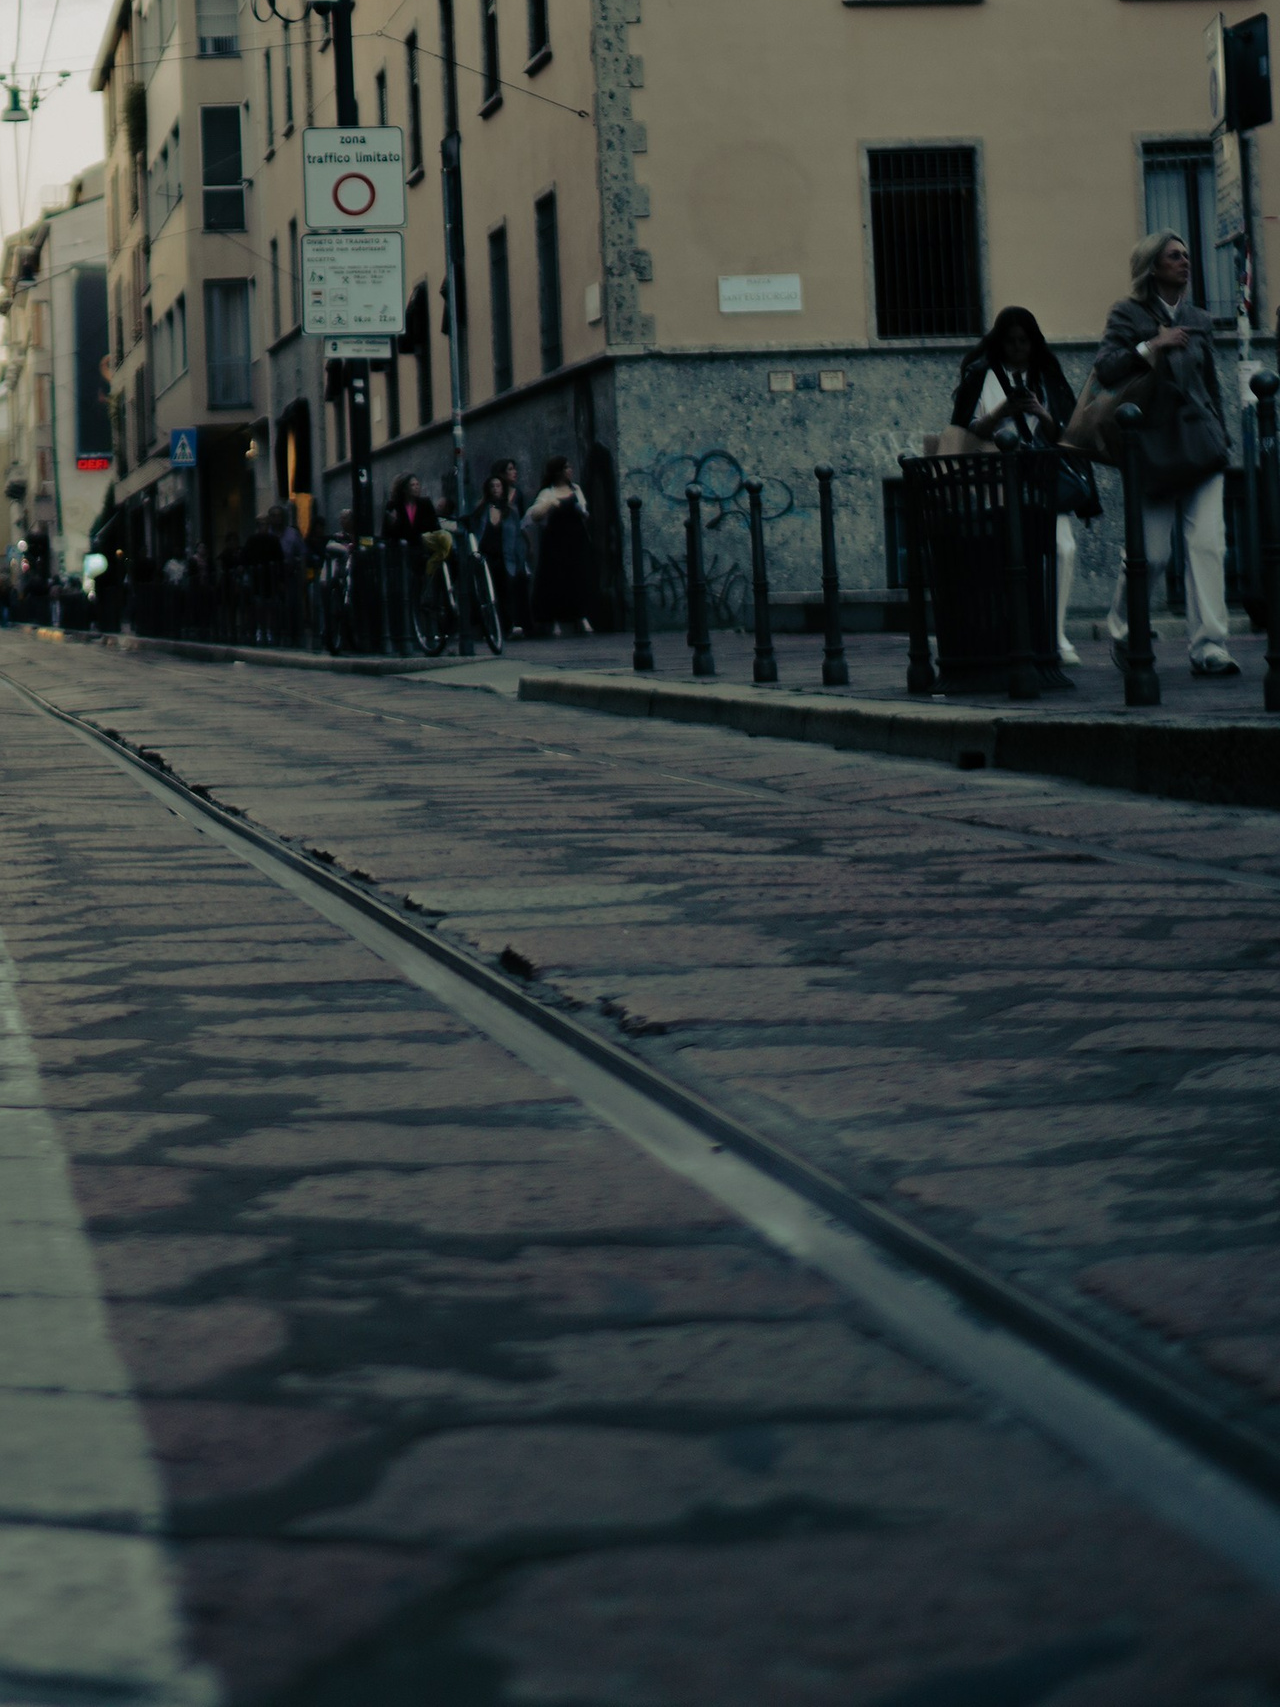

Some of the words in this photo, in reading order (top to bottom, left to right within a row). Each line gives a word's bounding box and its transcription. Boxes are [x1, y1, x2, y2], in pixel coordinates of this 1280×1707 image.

[340, 136, 366, 144] zona
[307, 152, 350, 164] traffico
[355, 151, 401, 163] limitato
